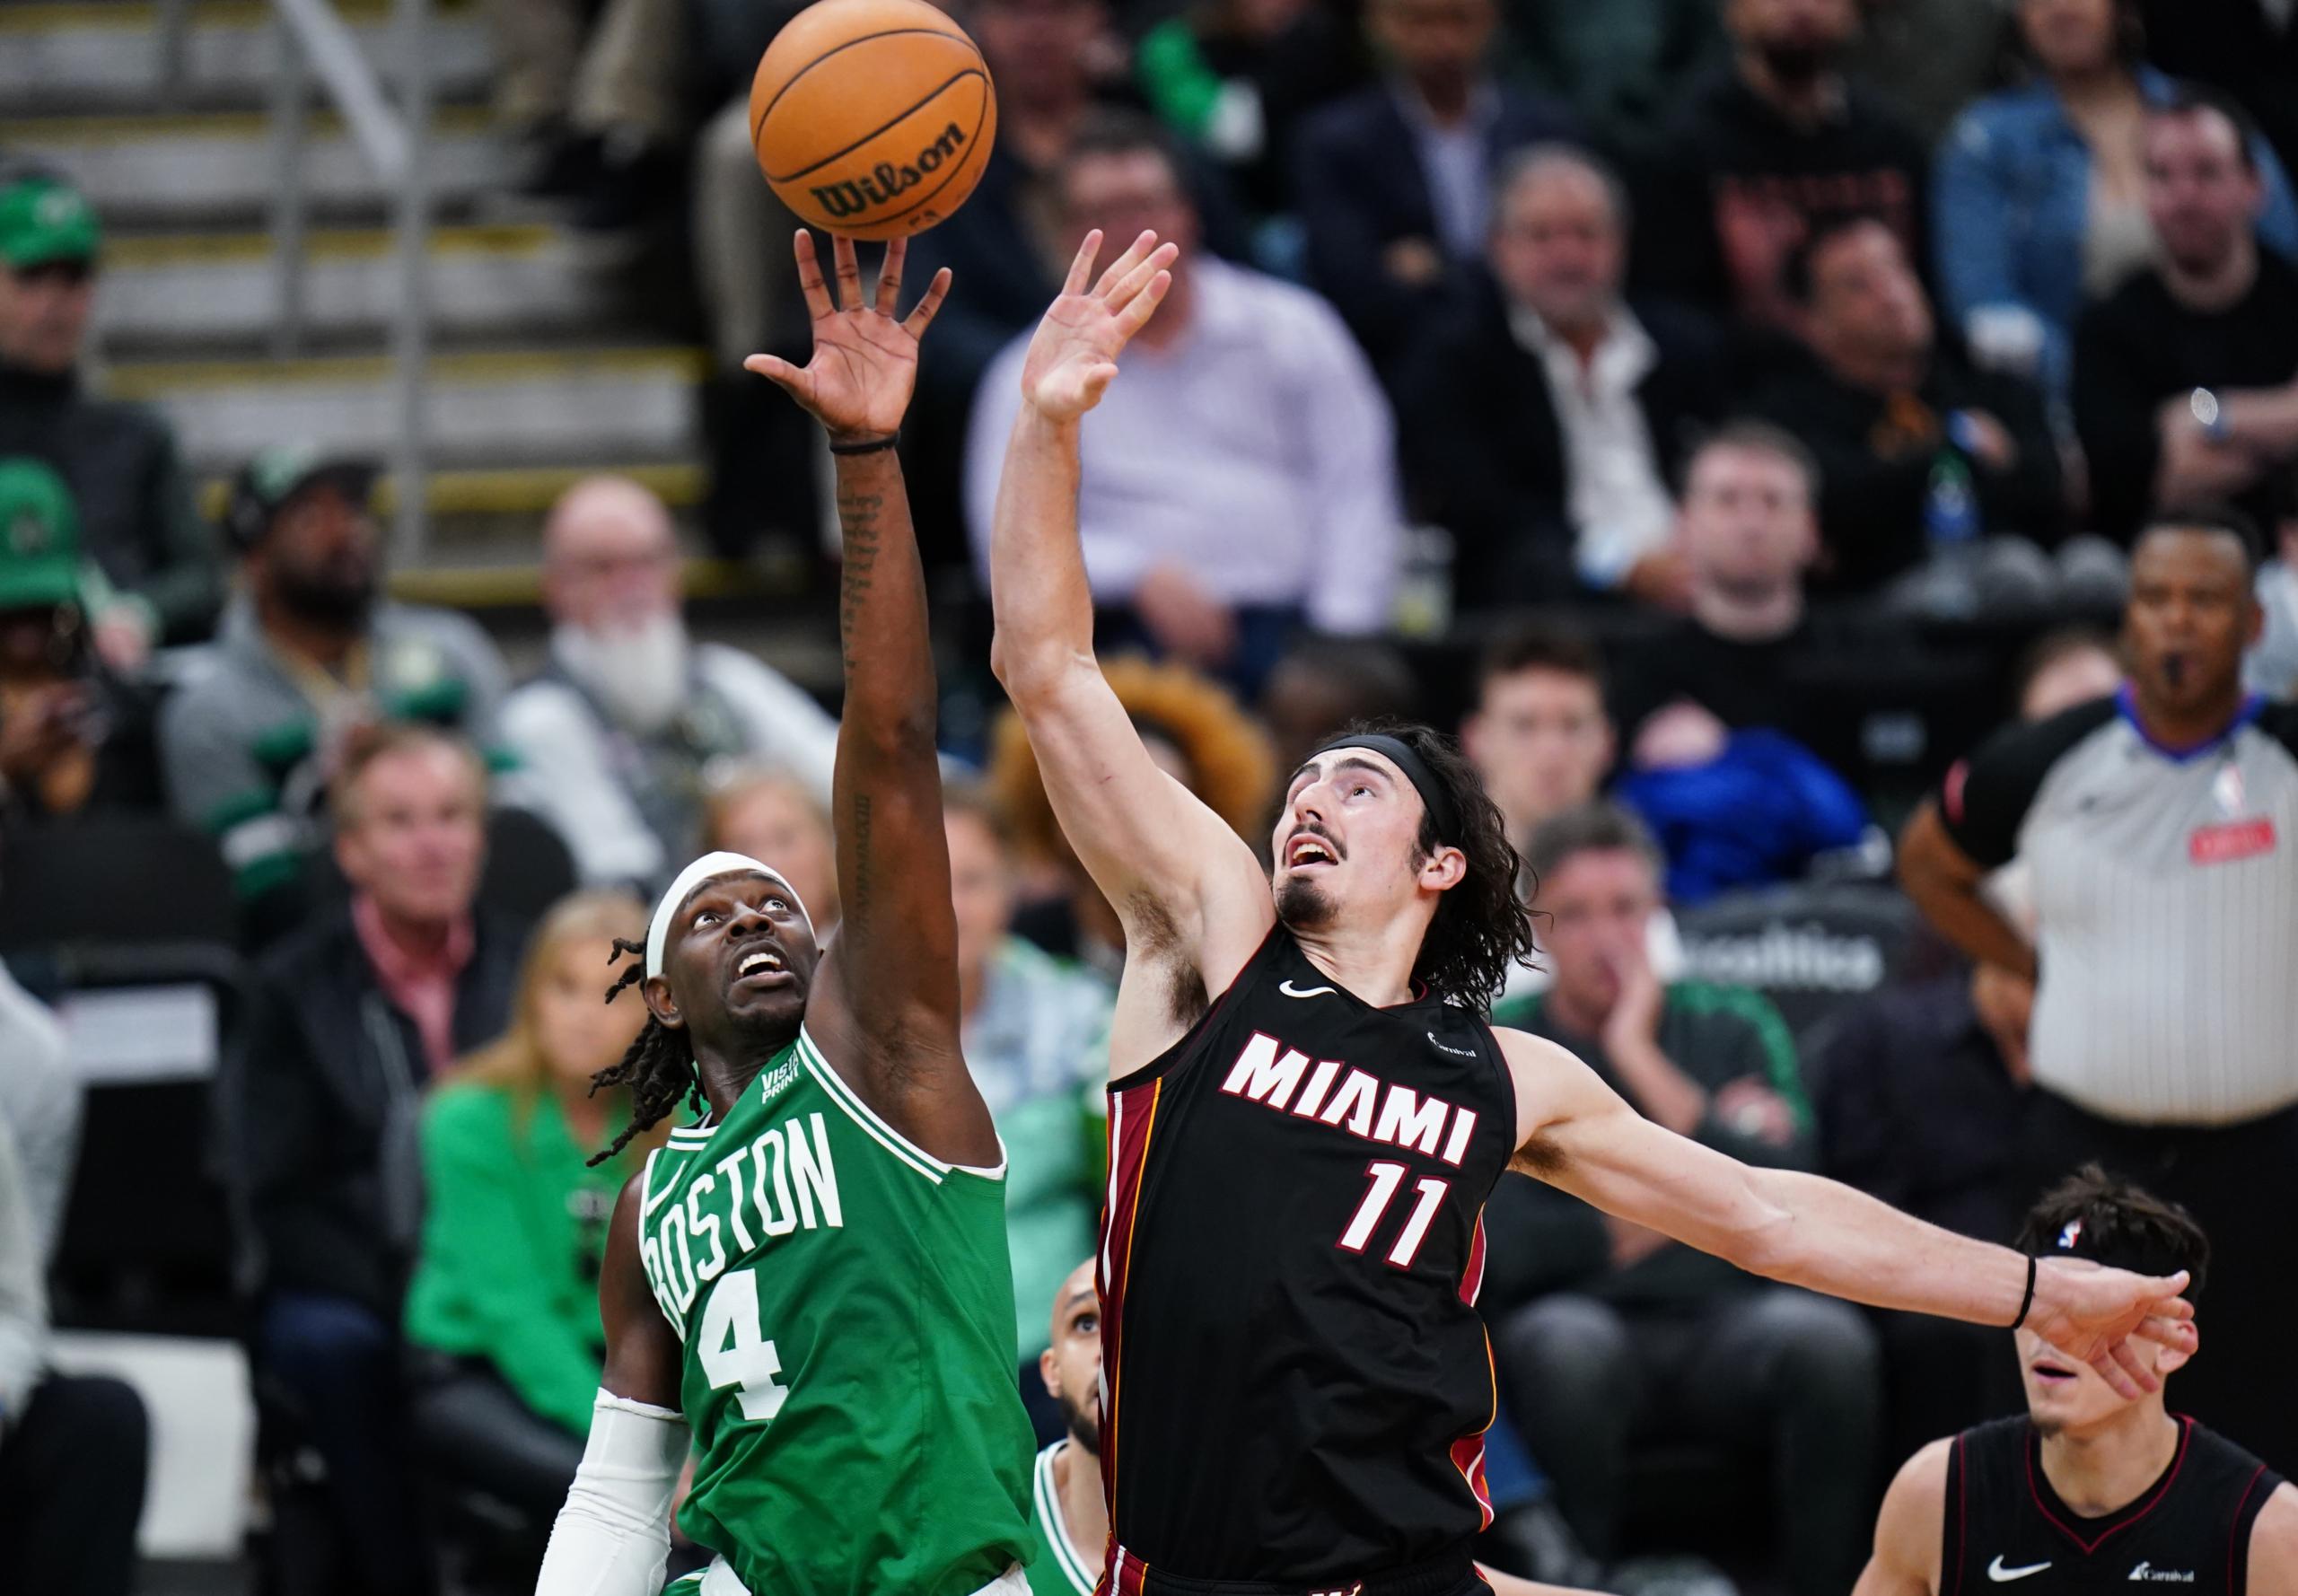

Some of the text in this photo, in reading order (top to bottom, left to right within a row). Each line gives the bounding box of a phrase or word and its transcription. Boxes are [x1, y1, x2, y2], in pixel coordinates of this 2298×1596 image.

[810, 121, 967, 218] Wilson
[761, 1048, 799, 1091] VISTA
[762, 1064, 799, 1104] PRINT
[1218, 1030, 1479, 1169] MIAMI
[1433, 1038, 1477, 1057] Carnival
[643, 1112, 843, 1344] BOSTON
[1335, 1159, 1452, 1270] 11
[697, 1268, 789, 1420] 4
